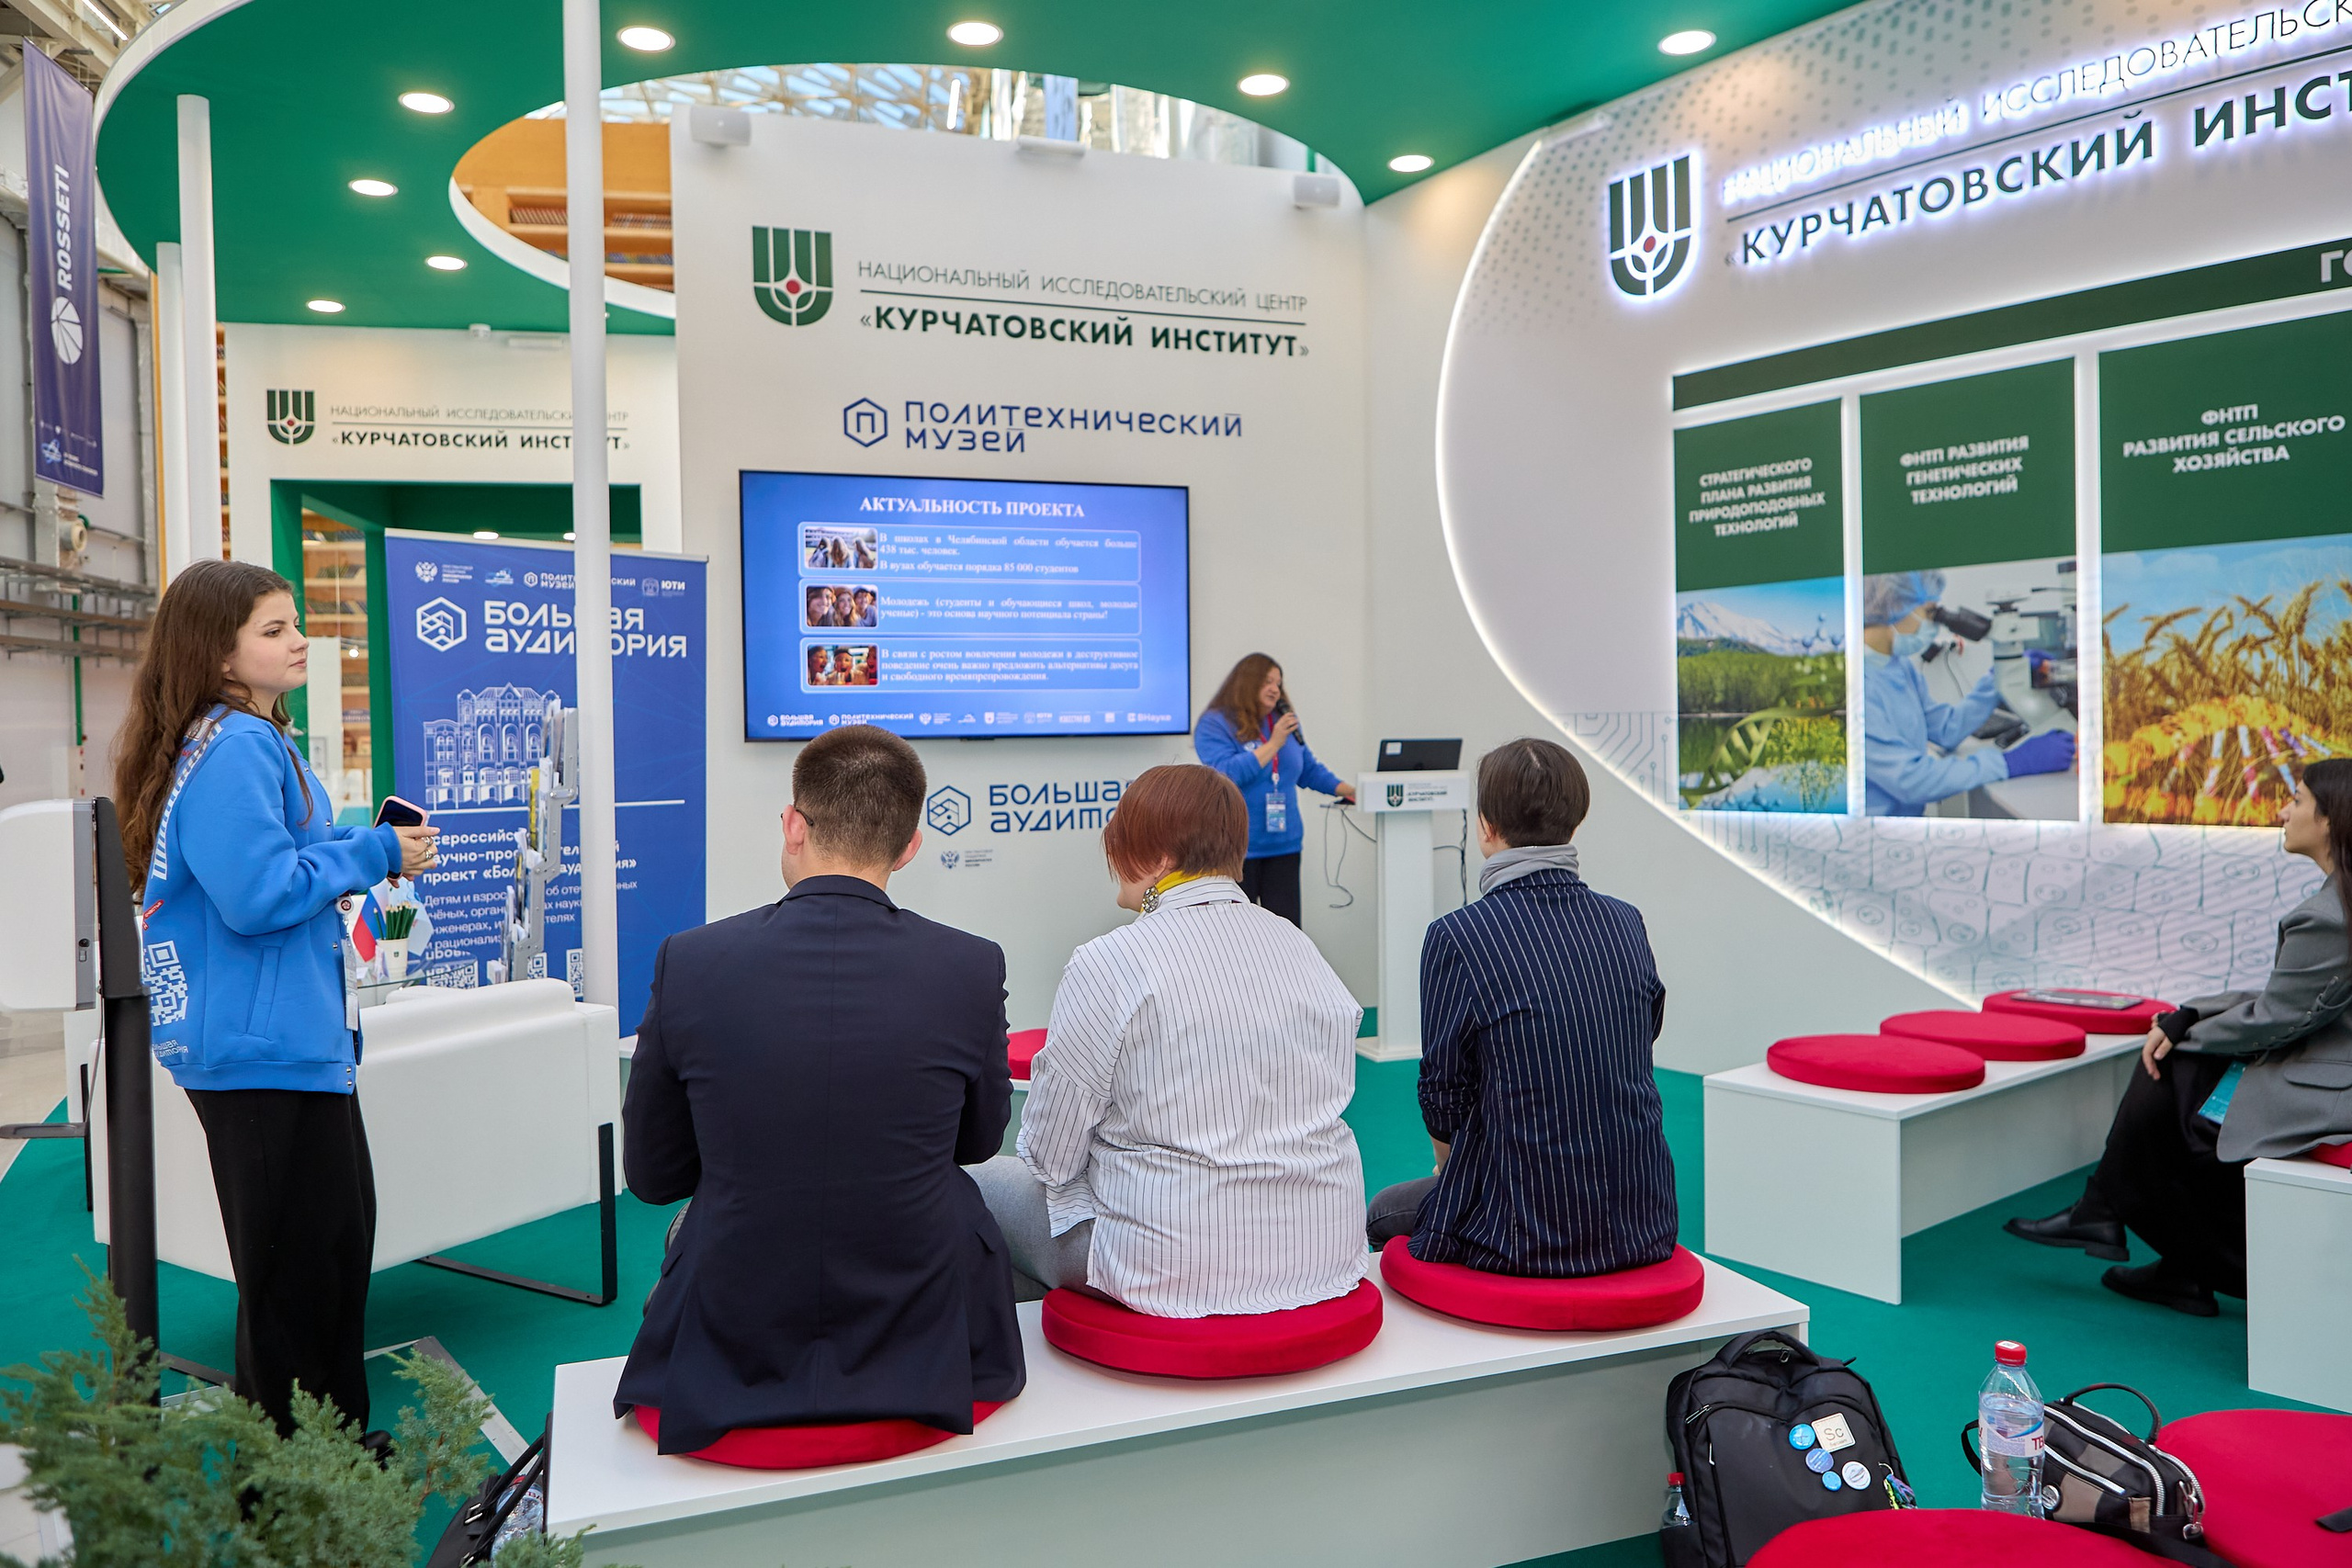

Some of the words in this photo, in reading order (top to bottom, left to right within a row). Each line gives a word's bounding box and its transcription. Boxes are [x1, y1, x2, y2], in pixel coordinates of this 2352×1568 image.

[1724, 108, 2153, 266] «КУРЧАТОВСКИЙ
[55, 164, 73, 291] ROSSETI
[859, 260, 1030, 290] НАЦИОНАЛЬНЫЙ
[1042, 275, 1247, 308] ИССЛЕДОВАТЕЛЬСКИЙ
[1256, 293, 1308, 312] ЦЕНТР
[860, 306, 1133, 346] «КУРЧАТОВСКИЙ
[1151, 325, 1310, 356] ИНСТИТУТ»
[331, 404, 440, 419] НАЦИОНАЛЬНЫЙ
[446, 407, 573, 422] ИССЛЕДОВАТЕЛЬСК
[609, 412, 628, 422] НТР
[2200, 403, 2258, 425] ФНТП
[333, 428, 508, 448] «КУРЧАТОВСКИЙ
[520, 434, 630, 451] ИНСТТ»
[906, 427, 1025, 453] МУЗЕЙ
[2122, 430, 2220, 458] РАЗВИТИЯ
[2223, 414, 2346, 446] СЕЛЬСКОГО
[1899, 447, 1944, 468] ФНТП
[1947, 434, 2030, 461] РАЗВИТИЯ
[2172, 444, 2290, 474] ХОЗЯЙСТВА
[1699, 457, 1813, 488] СТРАТЕГИЧЕСКОГО
[1905, 456, 2023, 486] ГЕНЕТИЧЕСКИХ
[1701, 486, 1746, 504] ПЛАНА
[1747, 475, 1813, 498] РАЗВИТИЯ
[1910, 473, 2018, 505] ТЕХНОЛОГИЙ
[860, 496, 1002, 515] АКТУАЛЬНОСТЬ
[1006, 502, 1085, 518] ПРОЕКТА
[1689, 491, 1826, 524] ПРИРОДОПОДОБНЫХ
[1713, 510, 1798, 537] ТЕХНОЛОГИЙ
[880, 546, 896, 554] 438
[1014, 536, 1049, 546] области
[880, 560, 888, 570] В
[1004, 563, 1014, 571] 85
[1017, 563, 1033, 572] 000
[662, 581, 685, 591] ЮТИ
[484, 600, 644, 631] БОЛЬАЯ
[485, 627, 687, 658] АУДИОРИЯ
[882, 649, 889, 658] В
[989, 781, 1133, 807] БОЛЬША
[423, 869, 478, 886] проект
[424, 894, 461, 908] Детям
[463, 895, 470, 904] и
[546, 886, 559, 897] об
[1824, 1427, 1844, 1441] Sc
